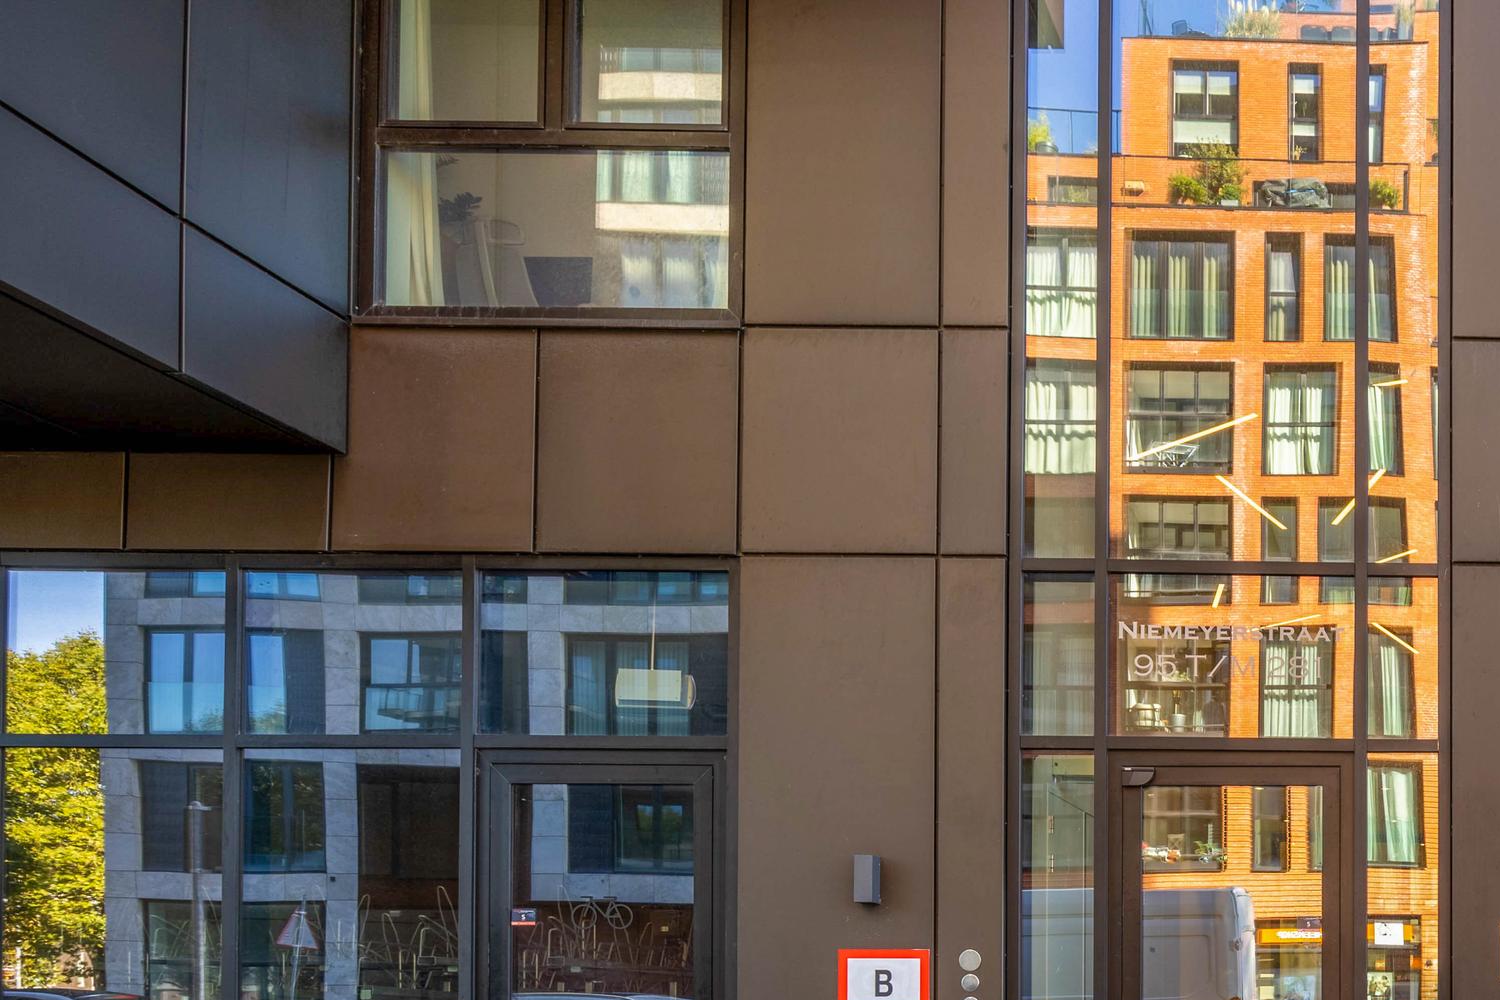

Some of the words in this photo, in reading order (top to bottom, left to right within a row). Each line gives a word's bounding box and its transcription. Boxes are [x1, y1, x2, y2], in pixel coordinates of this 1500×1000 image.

[1134, 654, 1176, 677] 95
[1266, 656, 1323, 679] 281
[874, 969, 894, 998] B
